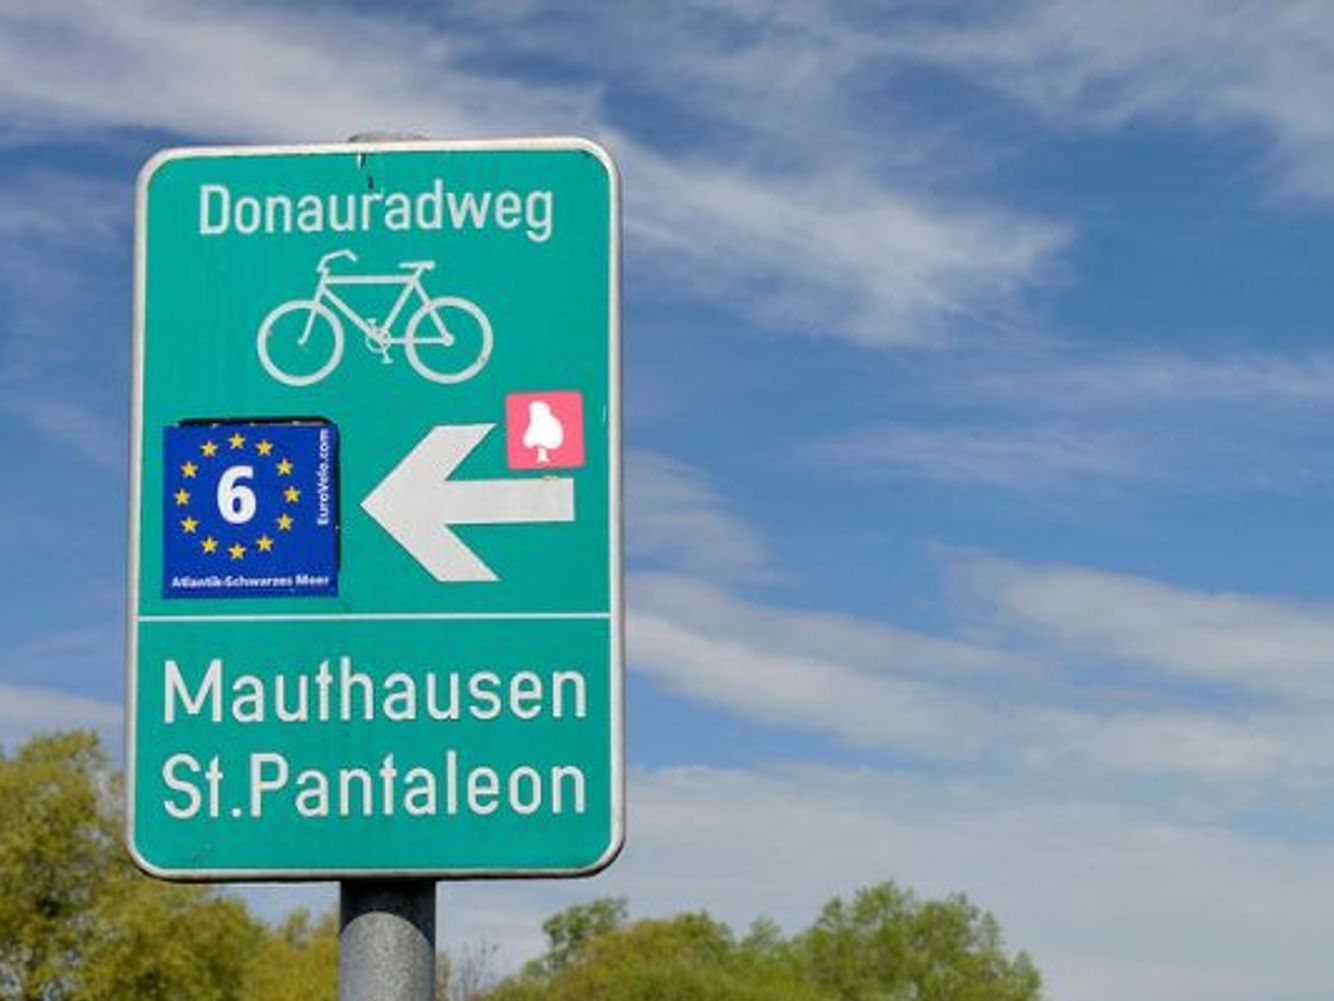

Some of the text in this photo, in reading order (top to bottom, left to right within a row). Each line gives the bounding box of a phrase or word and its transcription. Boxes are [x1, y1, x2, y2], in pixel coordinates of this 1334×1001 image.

[199, 179, 554, 242] Donauradweg
[216, 465, 257, 524] 6
[317, 428, 329, 525] EuroVelo.com
[295, 574, 329, 587] Meer
[164, 656, 587, 724] Mauthausen
